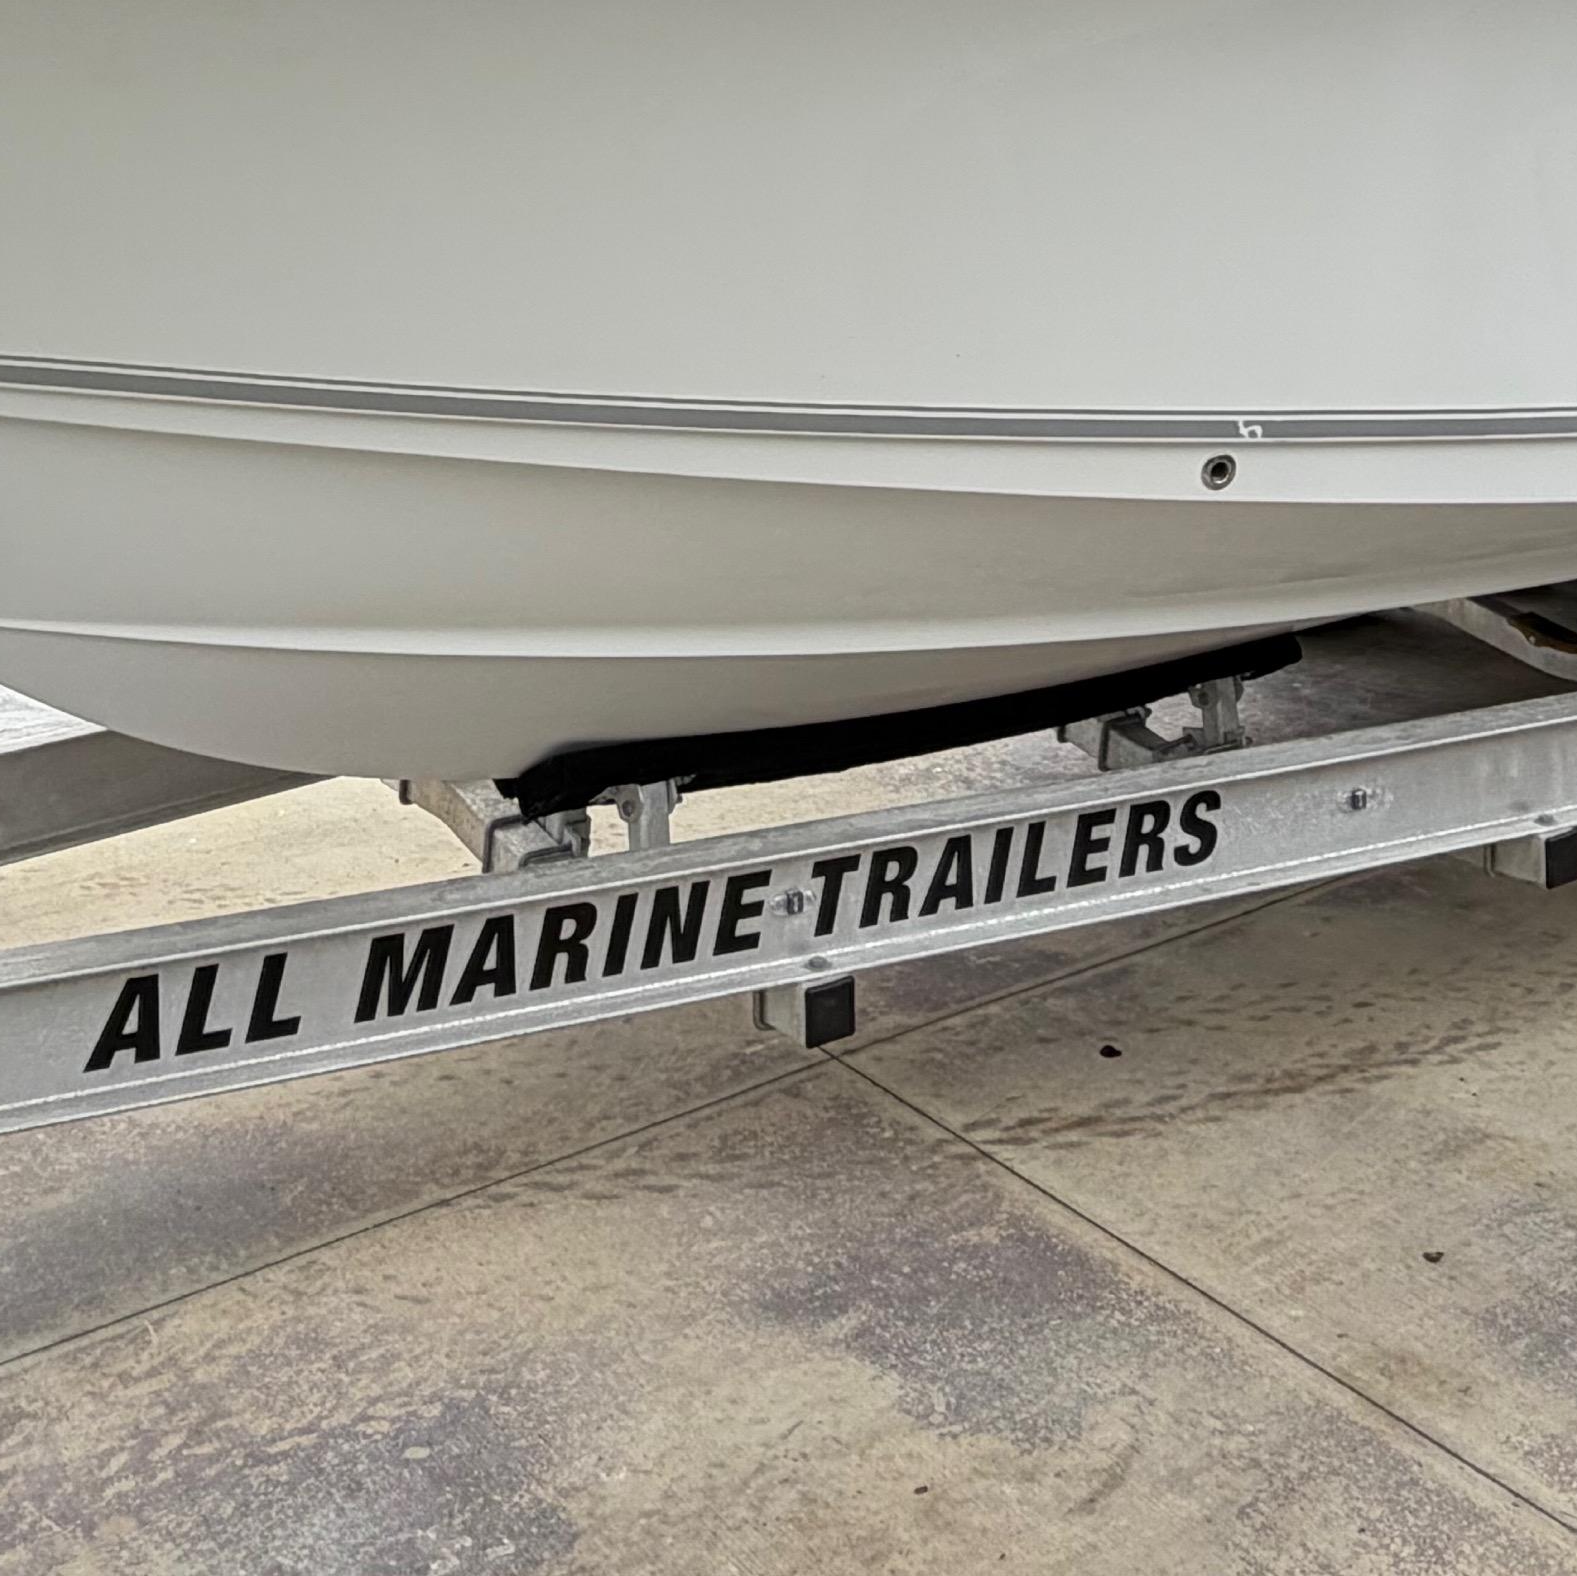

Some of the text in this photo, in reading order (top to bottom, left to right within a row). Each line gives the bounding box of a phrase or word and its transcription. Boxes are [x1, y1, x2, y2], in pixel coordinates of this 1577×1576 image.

[83, 789, 1222, 1074] ALL MARINE TRAILERS
